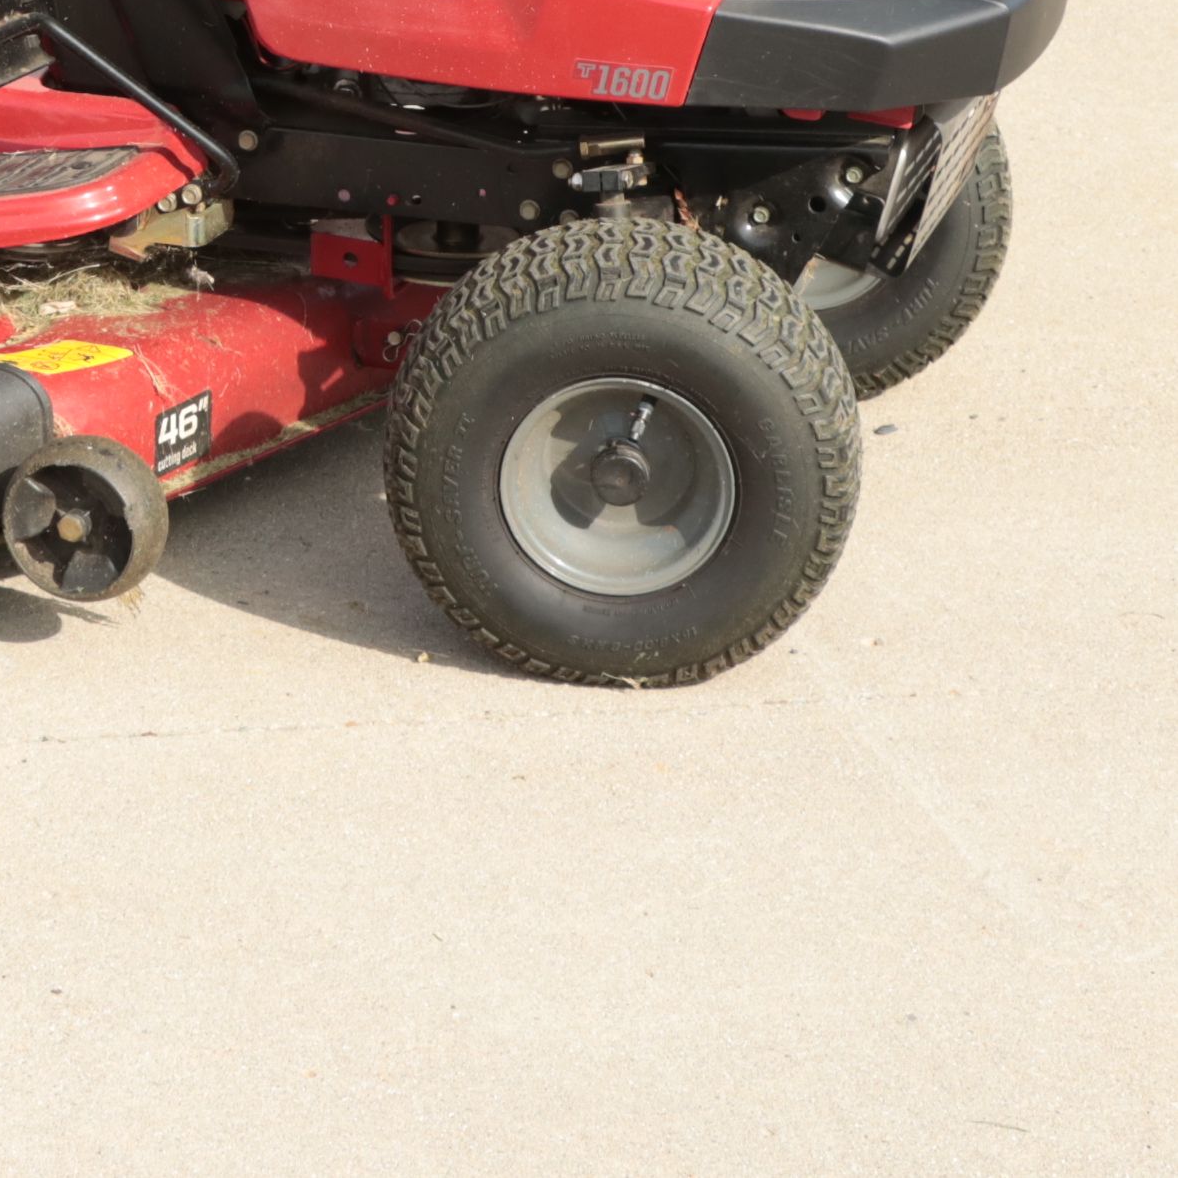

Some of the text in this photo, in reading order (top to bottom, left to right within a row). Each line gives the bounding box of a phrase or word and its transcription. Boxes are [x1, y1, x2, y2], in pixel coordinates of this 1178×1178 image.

[576, 62, 670, 101] T1600
[158, 395, 209, 445] 46"
[157, 440, 197, 472] cutting deck
